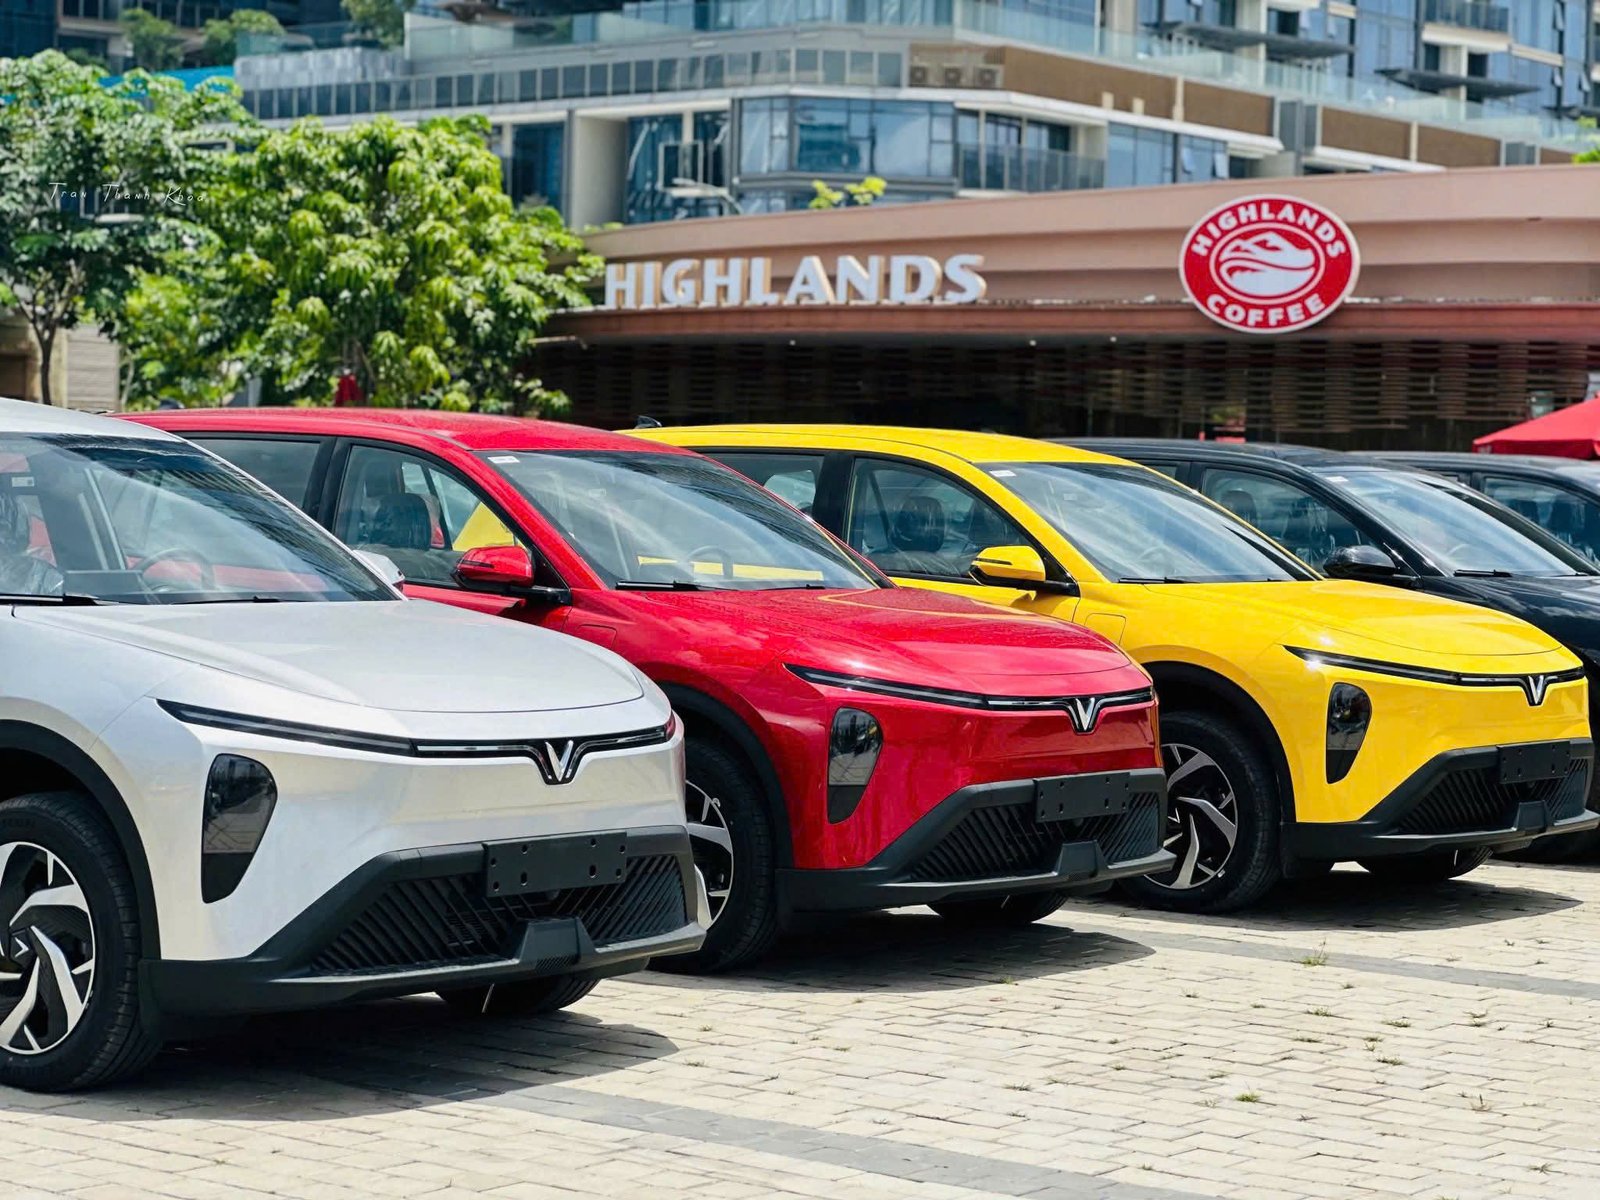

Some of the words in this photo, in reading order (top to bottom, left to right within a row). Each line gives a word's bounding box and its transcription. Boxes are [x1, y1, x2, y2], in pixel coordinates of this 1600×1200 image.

[1191, 202, 1346, 257] HIGHLANDS
[604, 254, 987, 306] HIGHLANDS
[1207, 293, 1326, 327] COFFEE
